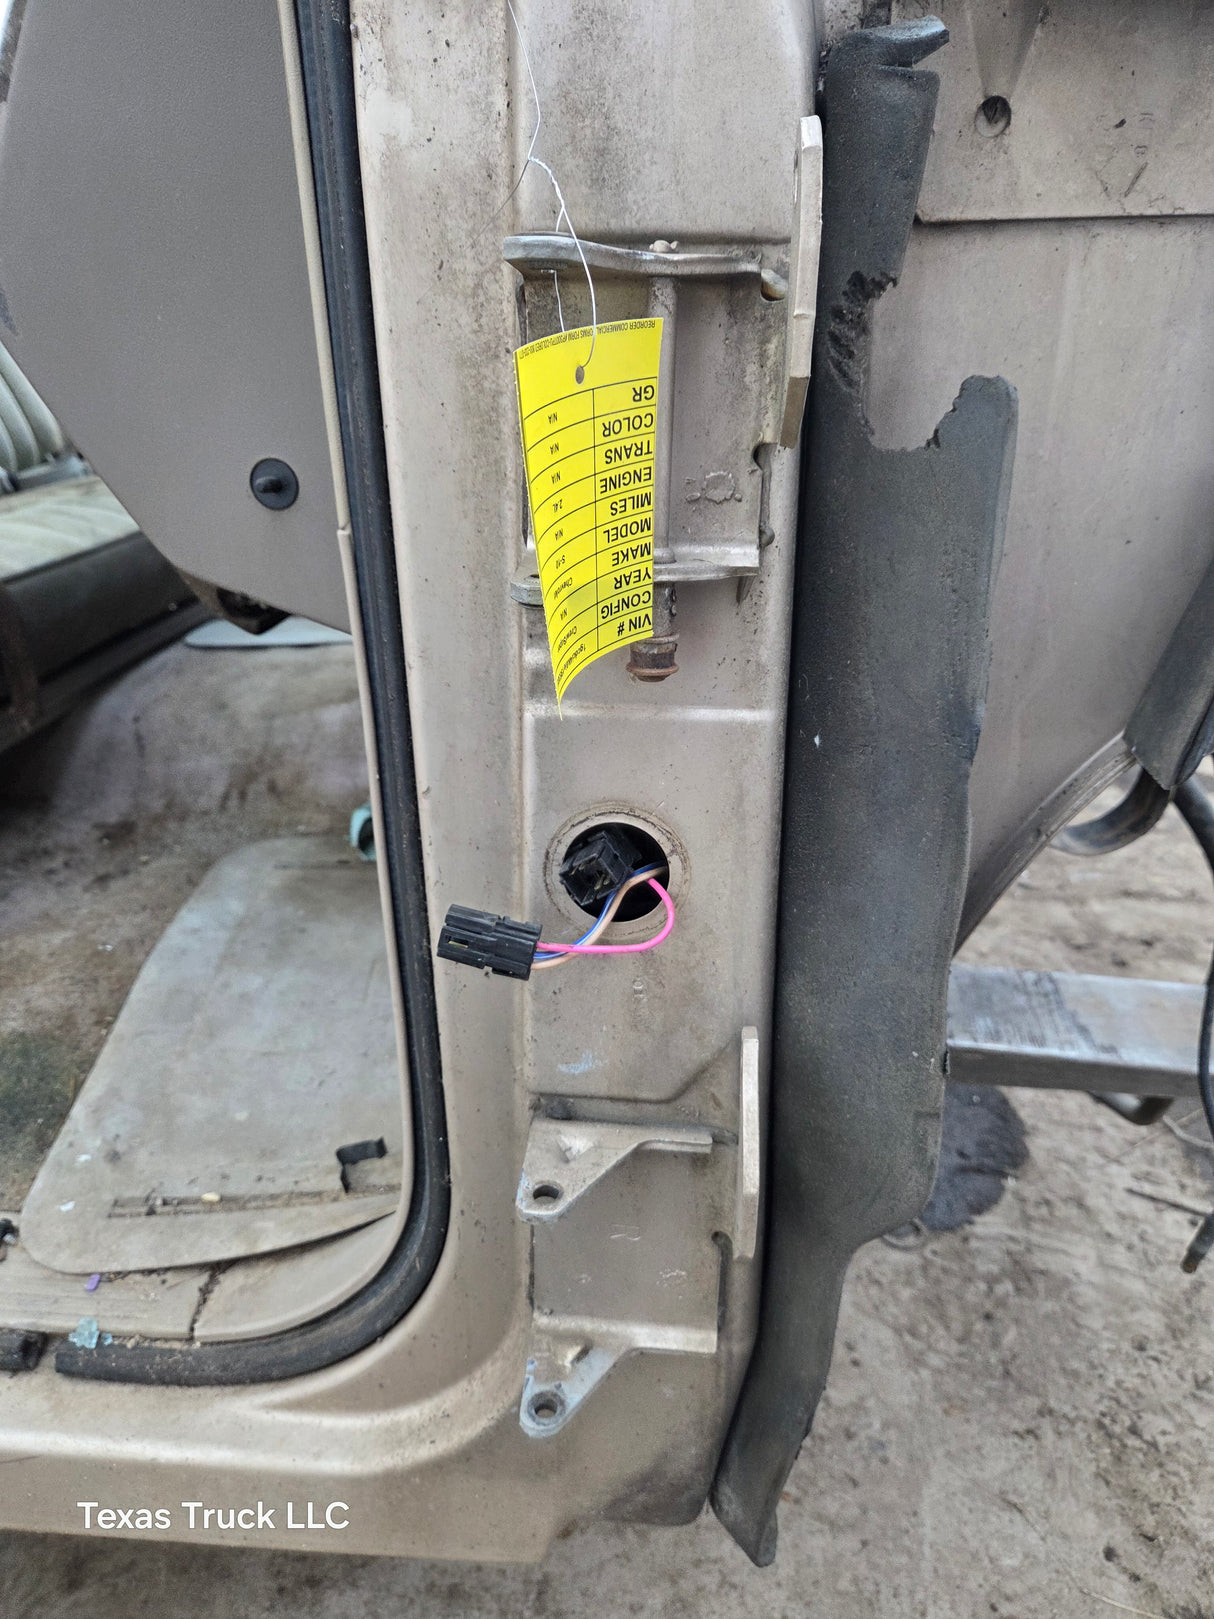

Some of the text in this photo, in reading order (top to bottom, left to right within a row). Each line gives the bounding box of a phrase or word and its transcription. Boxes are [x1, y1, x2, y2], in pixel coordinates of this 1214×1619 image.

[599, 322, 629, 336] COMMERCIAL
[628, 320, 656, 331] REORDER
[632, 384, 656, 402] GR
[602, 412, 654, 438] COLOR
[549, 442, 560, 456] N/A
[604, 439, 653, 465] TRANS
[599, 466, 652, 495] ENGINE
[610, 491, 651, 516] MILES
[603, 517, 651, 544] MODEL
[611, 542, 651, 567] MAKE
[613, 566, 652, 590] YEAR
[600, 590, 651, 620] CONFIG
[616, 613, 652, 637] VIN #
